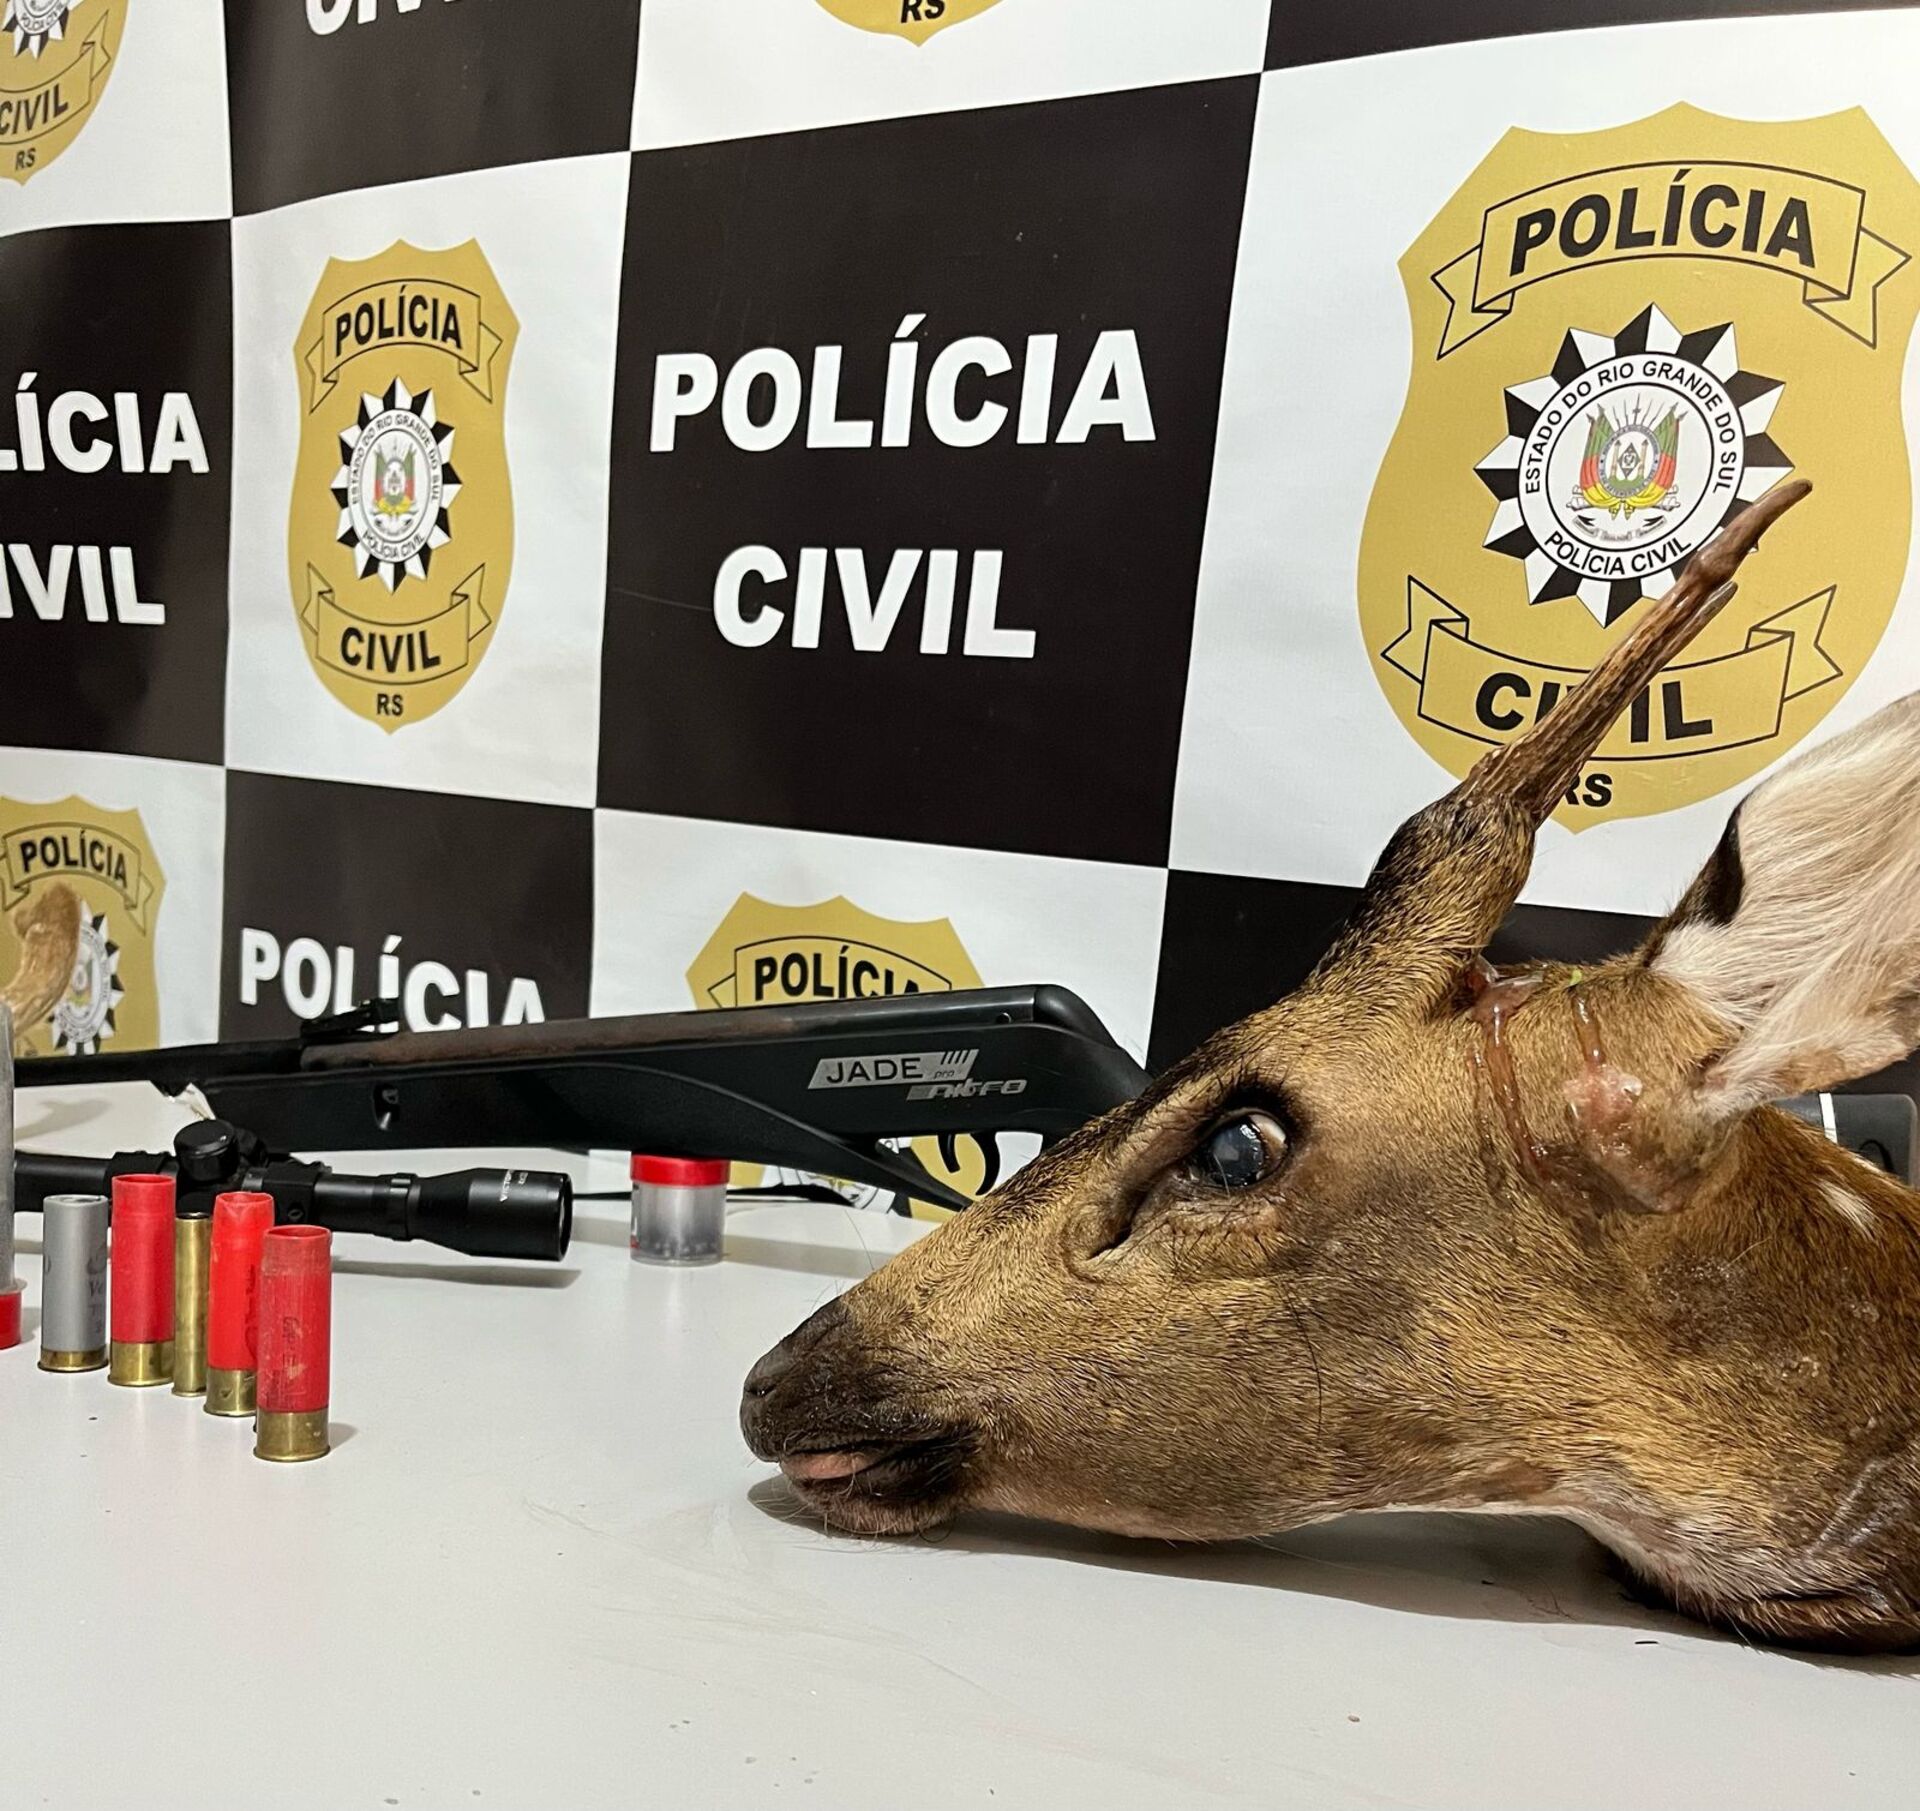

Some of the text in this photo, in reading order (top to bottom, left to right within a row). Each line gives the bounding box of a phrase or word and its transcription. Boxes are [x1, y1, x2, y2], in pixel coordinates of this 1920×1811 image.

[900, 0, 946, 23] RS
[0, 84, 69, 136] CIVIL
[15, 147, 36, 171] RS
[1509, 168, 1815, 277] POLÍCIA
[335, 284, 462, 358] POLÍCIA
[650, 313, 1157, 452] POLÍCIA
[1561, 380, 1592, 410] DO
[1597, 362, 1634, 387] RIO
[1642, 360, 1723, 413] GRANDE
[0, 372, 209, 473] ÍCIA
[1714, 412, 1736, 445] DO
[1525, 409, 1562, 494] ESTADO
[1712, 451, 1737, 496] SUL
[1544, 530, 1692, 576] POLÍCIA CIVIL
[713, 545, 1036, 659] CIVIL
[340, 626, 441, 673] CIVIL
[376, 692, 404, 716] RS
[1475, 672, 1713, 744] CIIL
[20, 829, 128, 889] POLÍCIA
[240, 927, 545, 1033] POLÍCIA
[826, 1057, 924, 1084] JADE
